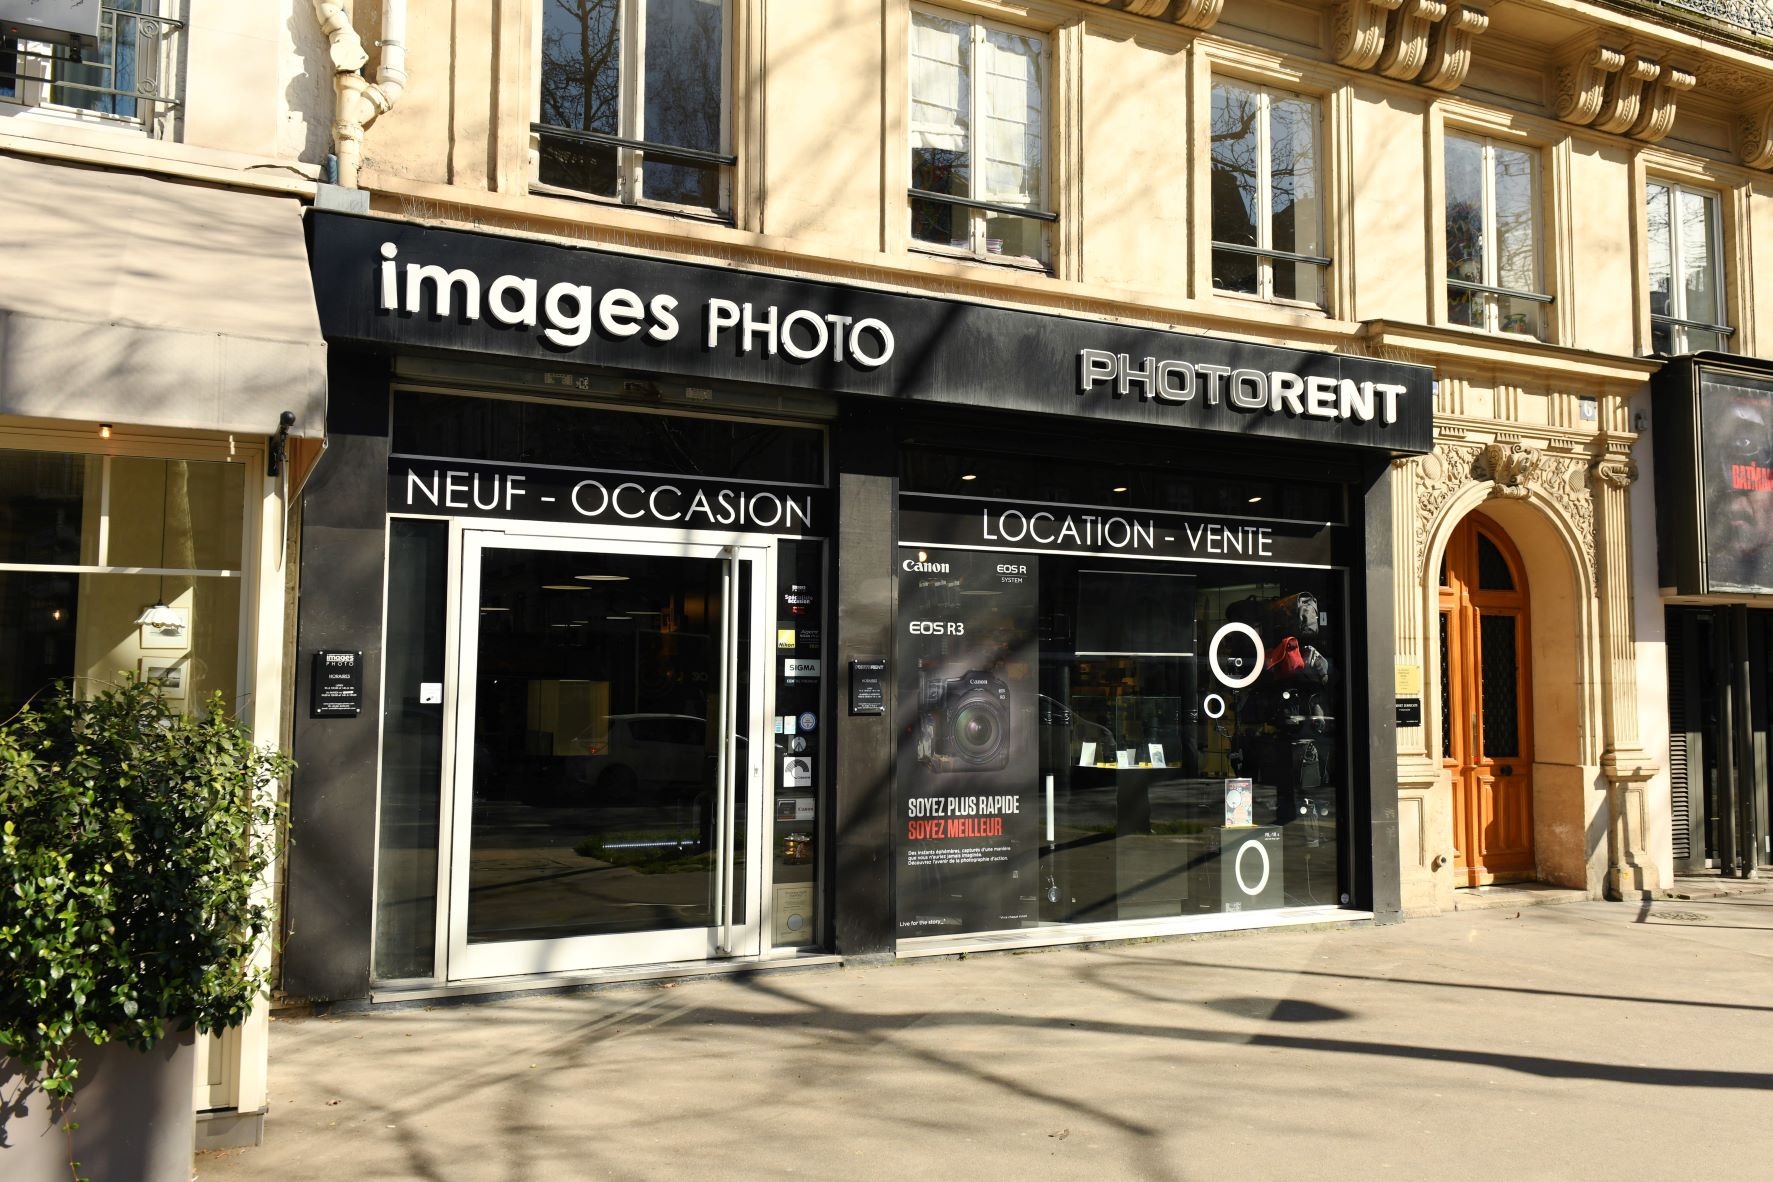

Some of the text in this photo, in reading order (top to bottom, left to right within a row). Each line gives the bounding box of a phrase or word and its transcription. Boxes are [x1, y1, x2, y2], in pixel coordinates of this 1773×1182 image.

[379, 241, 896, 368] images PHOTO
[1079, 347, 1408, 426] PHOTORENT
[406, 468, 526, 511] NEUF
[571, 479, 811, 528] OCCASION
[982, 508, 1154, 549] LOCATION
[1184, 522, 1273, 557] VENTE
[902, 559, 950, 573] Canon
[996, 564, 1027, 574] EOS R
[909, 621, 965, 636] EOS R3
[789, 664, 816, 672] SIGMA
[908, 795, 1020, 818] SOYEZ PLUS RAPIDE
[908, 817, 1002, 840] SOYEZ MEILLEUR
